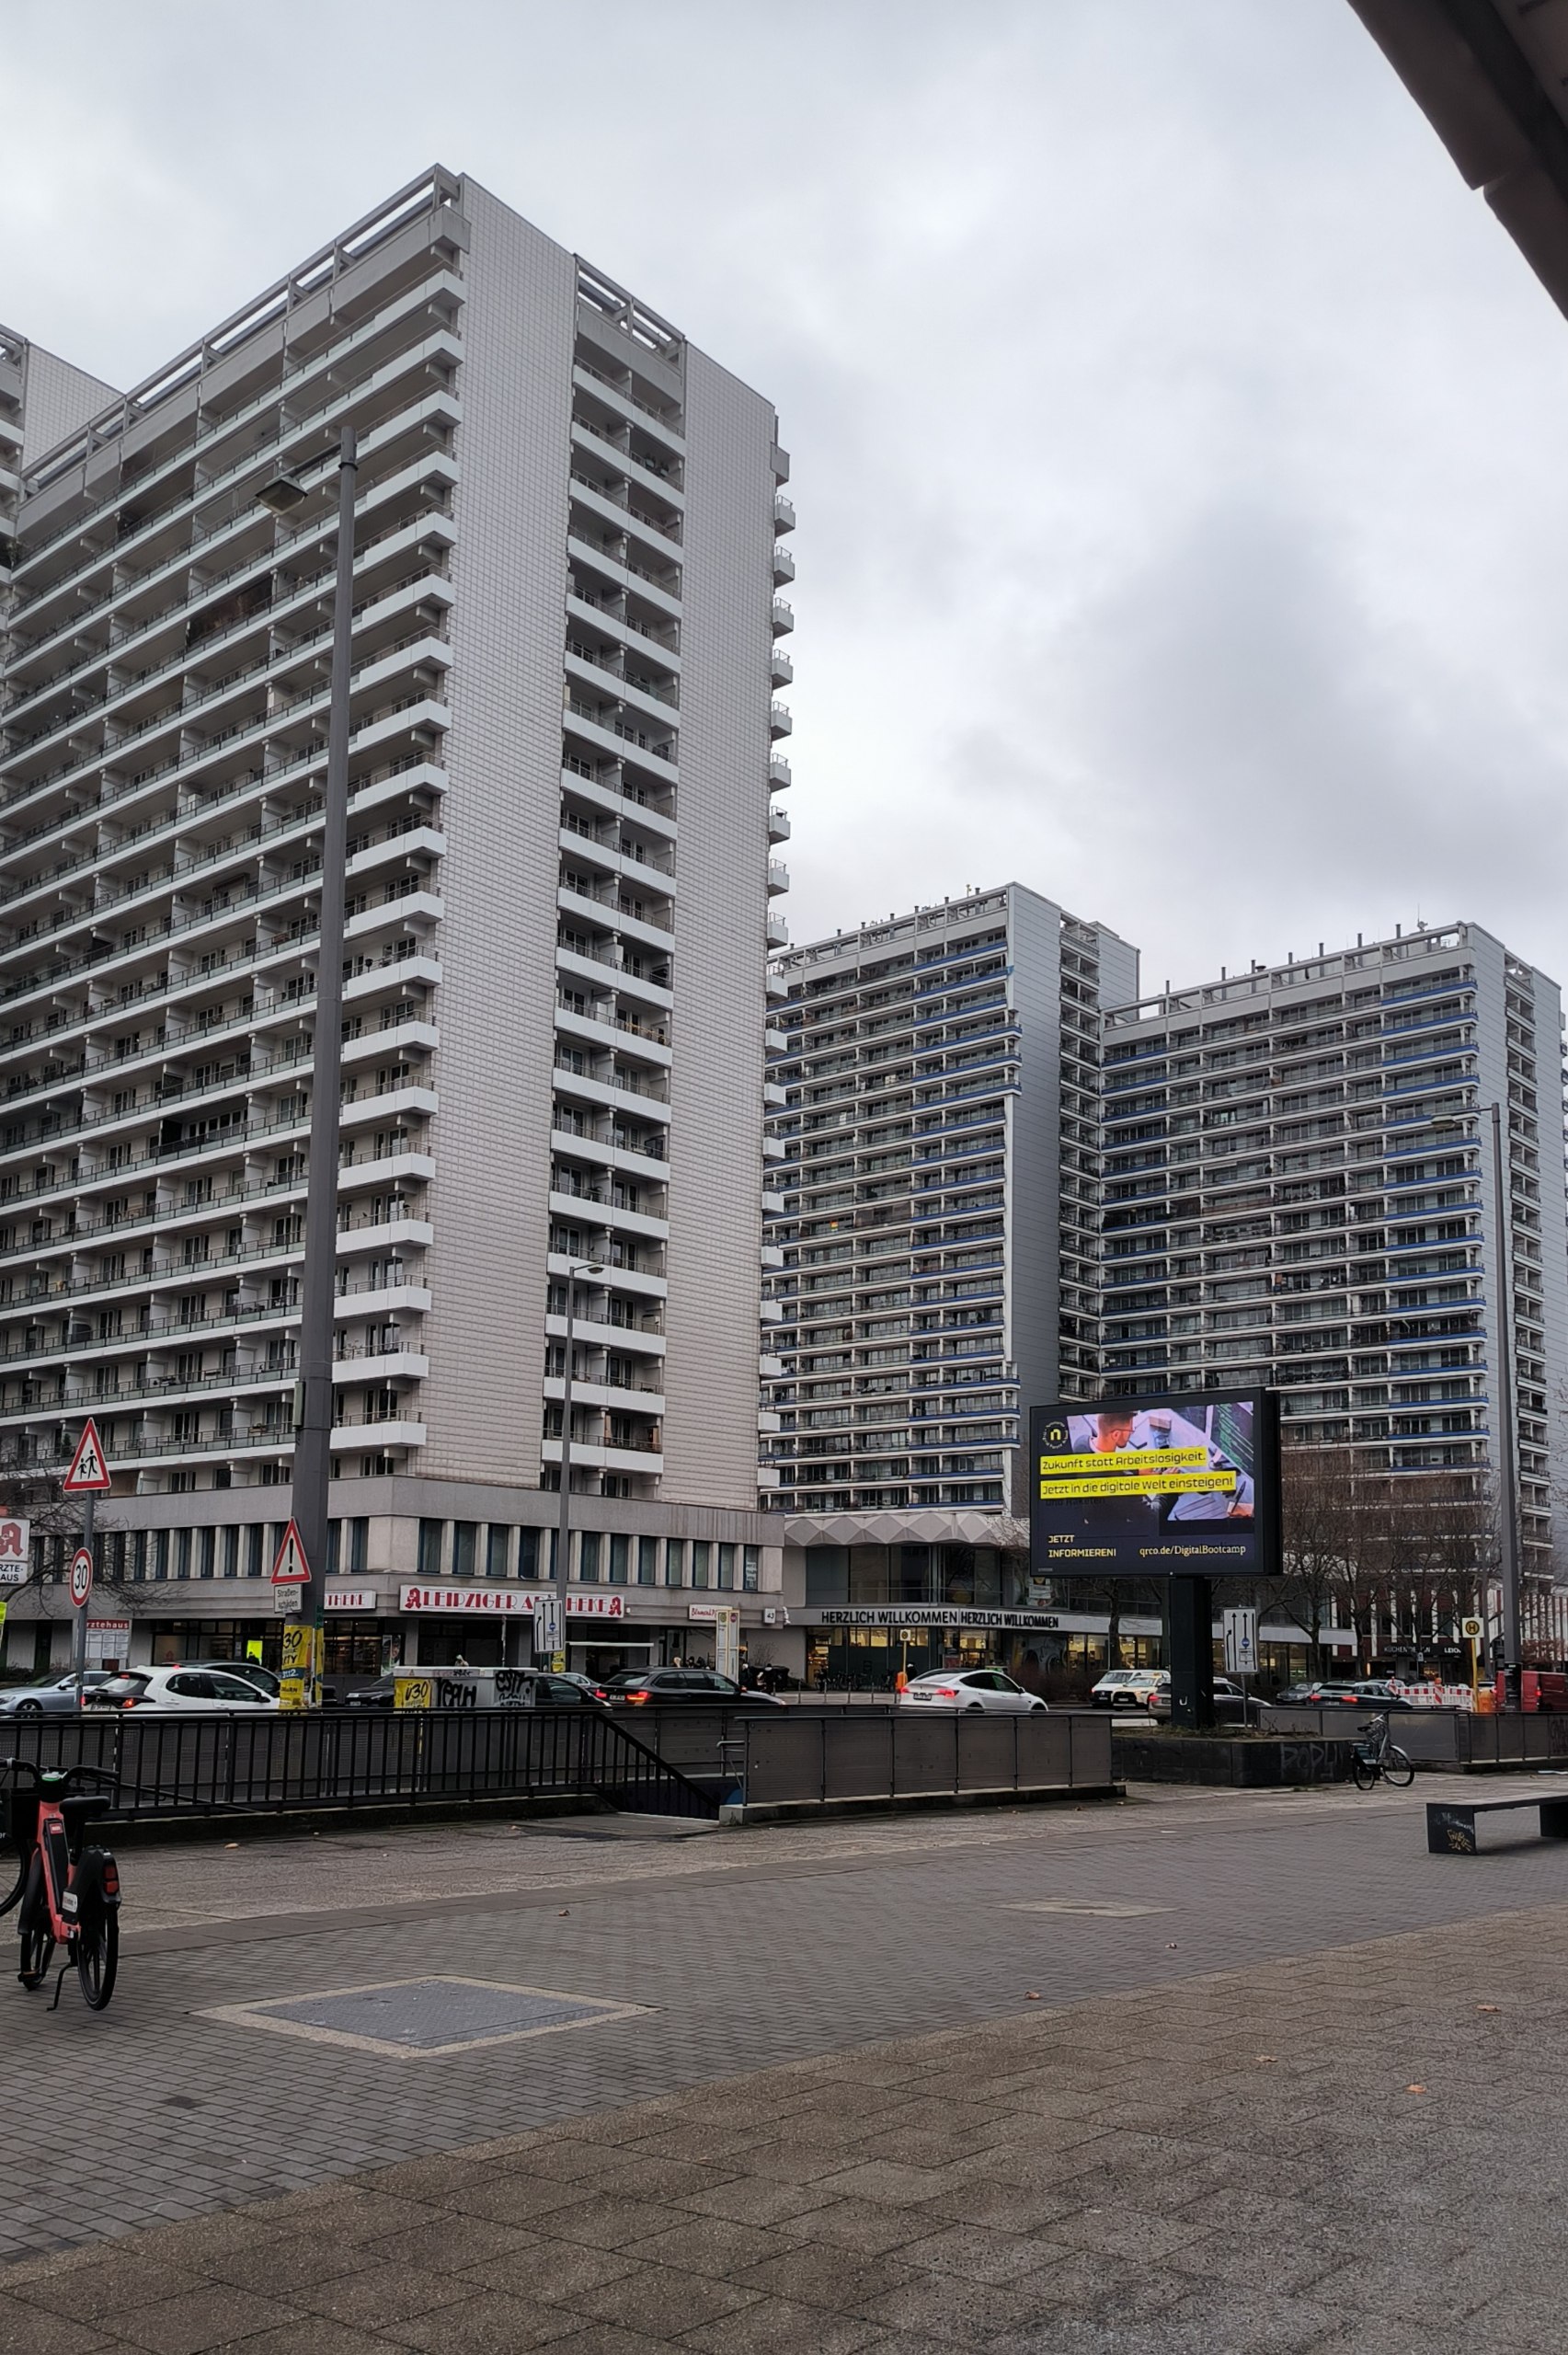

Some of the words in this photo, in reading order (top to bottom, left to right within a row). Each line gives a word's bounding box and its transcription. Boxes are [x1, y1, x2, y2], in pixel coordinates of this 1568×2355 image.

[1043, 1458, 1083, 1470] Zukunft
[1086, 1457, 1114, 1467] statt
[1116, 1451, 1206, 1465] Arbeitslosigkeit.
[1043, 1486, 1070, 1495] Jetzt
[1071, 1484, 1081, 1493] in
[1082, 1483, 1098, 1493] die
[1100, 1480, 1140, 1494] digitale
[1142, 1479, 1167, 1489] Welt
[1169, 1476, 1233, 1489] einsteigen!
[1047, 1534, 1075, 1544] JETZT
[1139, 1545, 1247, 1558] qrco.de/DigitalBootcamp
[0, 1564, 24, 1573] RZTE-
[0, 1573, 19, 1582] AUS
[74, 1564, 88, 1591] 30
[326, 1593, 365, 1606] THEKE
[423, 1591, 518, 1610] LEIPZIGER
[521, 1594, 608, 1614] AHEKE
[821, 1610, 874, 1624] HERZLICH
[877, 1610, 958, 1625] WILLKOMMEN
[960, 1612, 1002, 1626] HERZLICH
[1003, 1614, 1059, 1628] WILLKOMMEN
[86, 1621, 129, 1629] rztehaus
